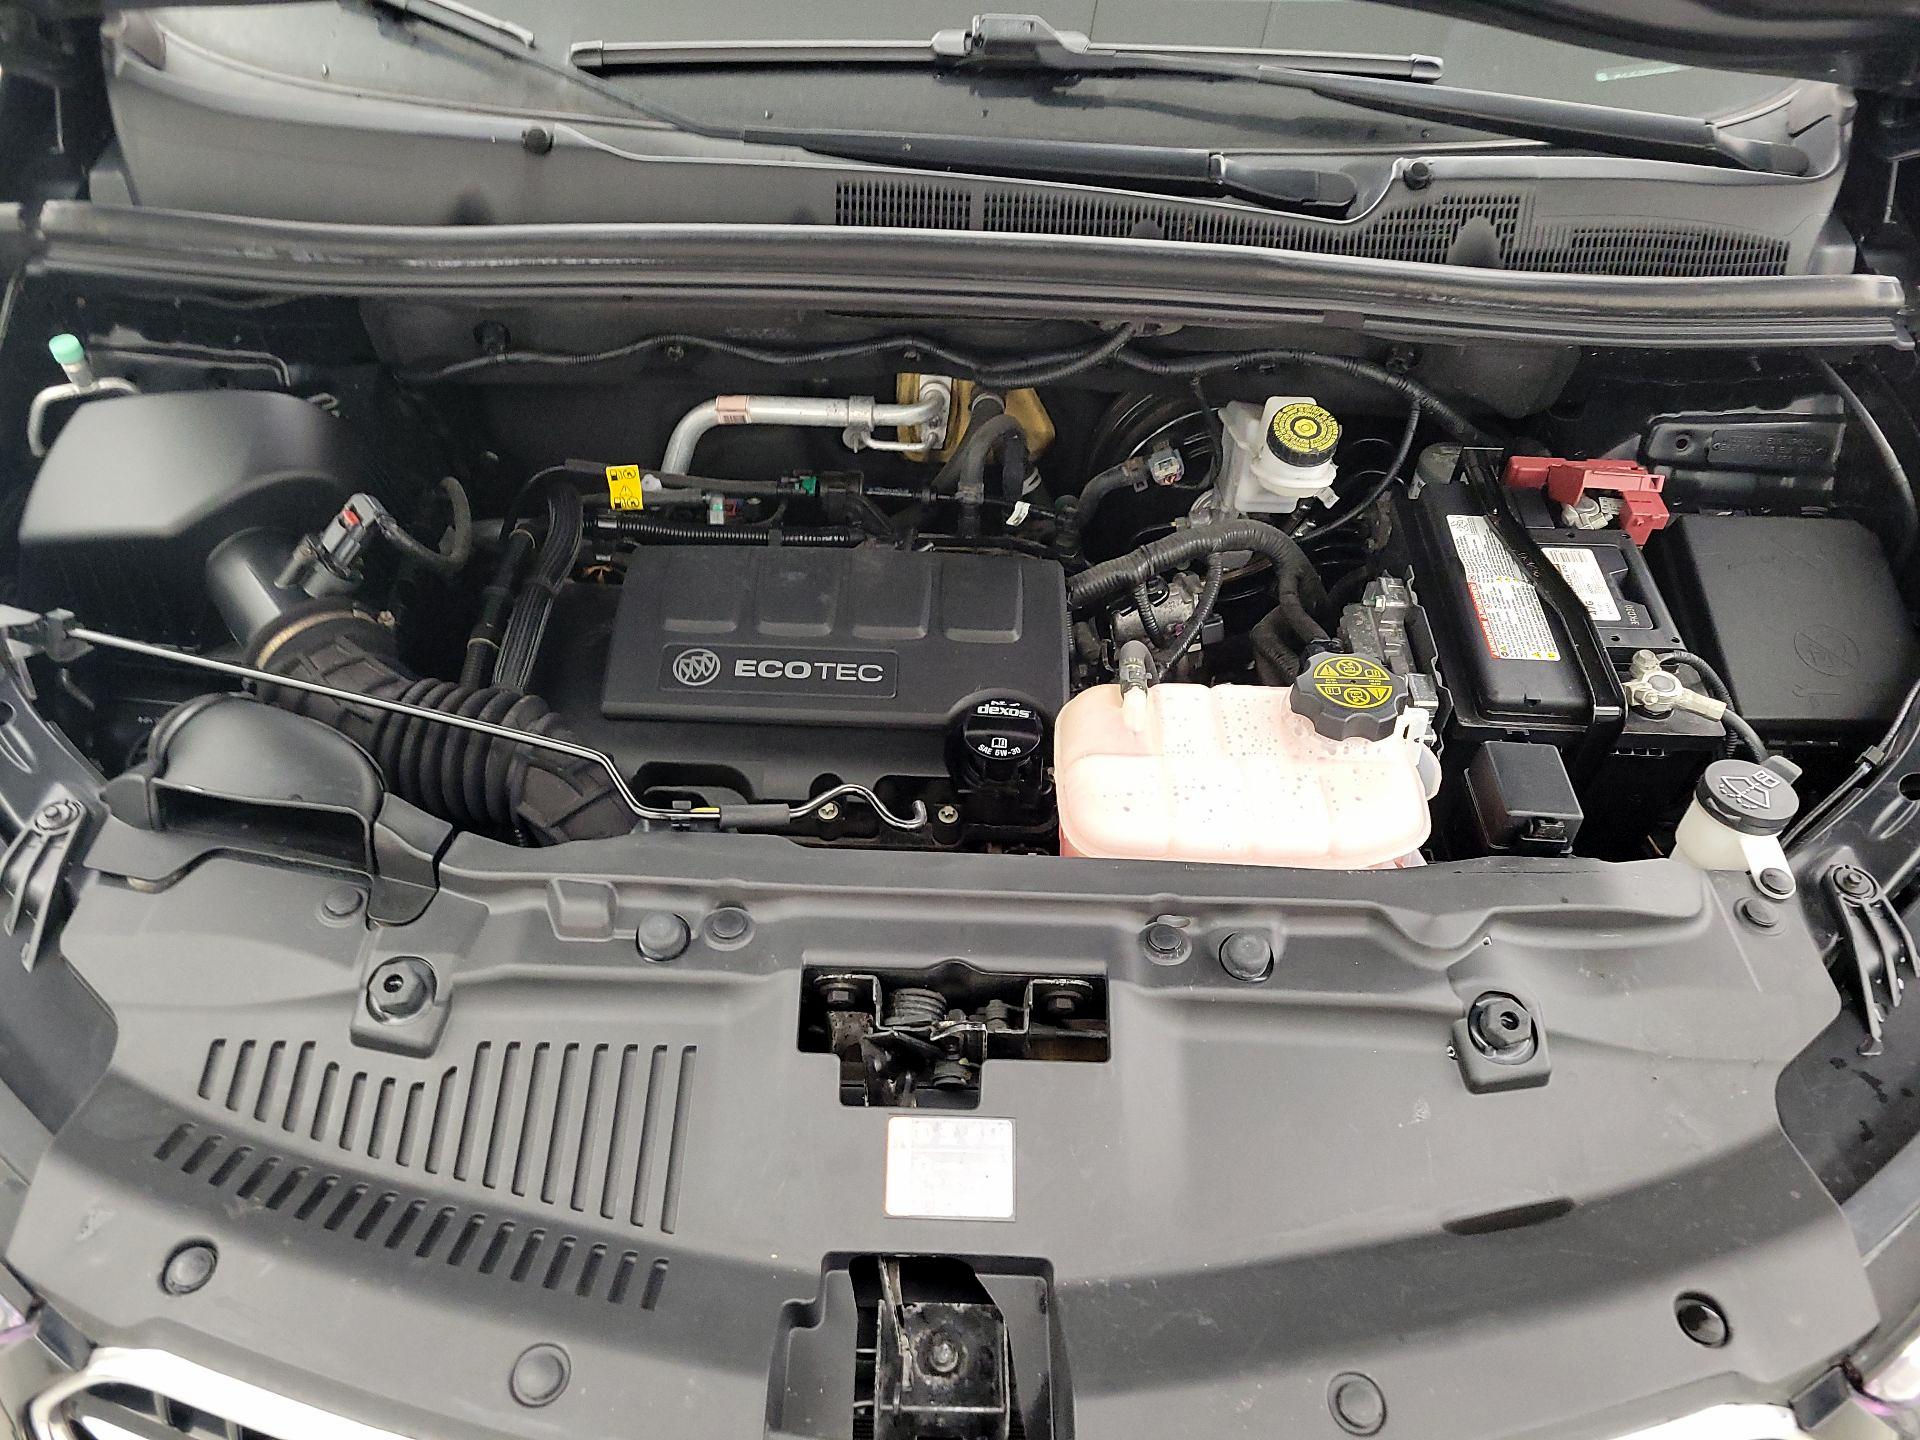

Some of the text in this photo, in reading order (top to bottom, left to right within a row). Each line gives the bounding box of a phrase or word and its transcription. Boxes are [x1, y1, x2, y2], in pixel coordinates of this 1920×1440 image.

[734, 659, 884, 682] ECOTEC
[977, 704, 1032, 719] dexos
[978, 743, 993, 755] SAE
